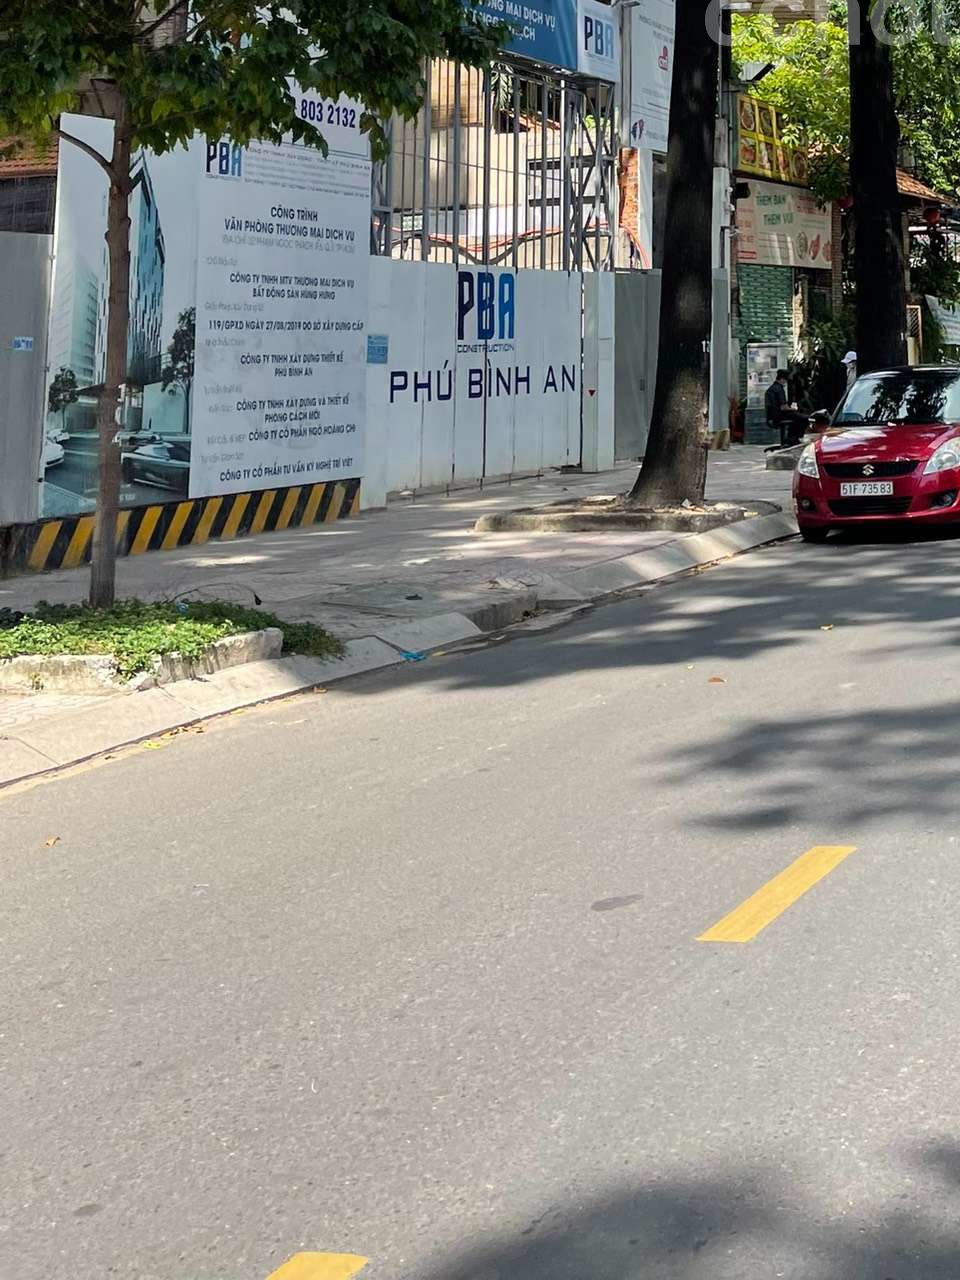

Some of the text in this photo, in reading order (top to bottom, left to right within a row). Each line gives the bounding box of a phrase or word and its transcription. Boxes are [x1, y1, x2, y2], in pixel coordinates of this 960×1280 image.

[584, 16, 614, 59] PBA
[301, 99, 356, 128] 803 2132
[206, 141, 242, 176] PBA
[271, 204, 294, 220] CÔNG
[458, 271, 514, 340] PBA
[457, 344, 514, 353] CONSTRUCTION
[390, 359, 576, 403] PHÚ BÌNH AN
[243, 468, 251, 479] TY
